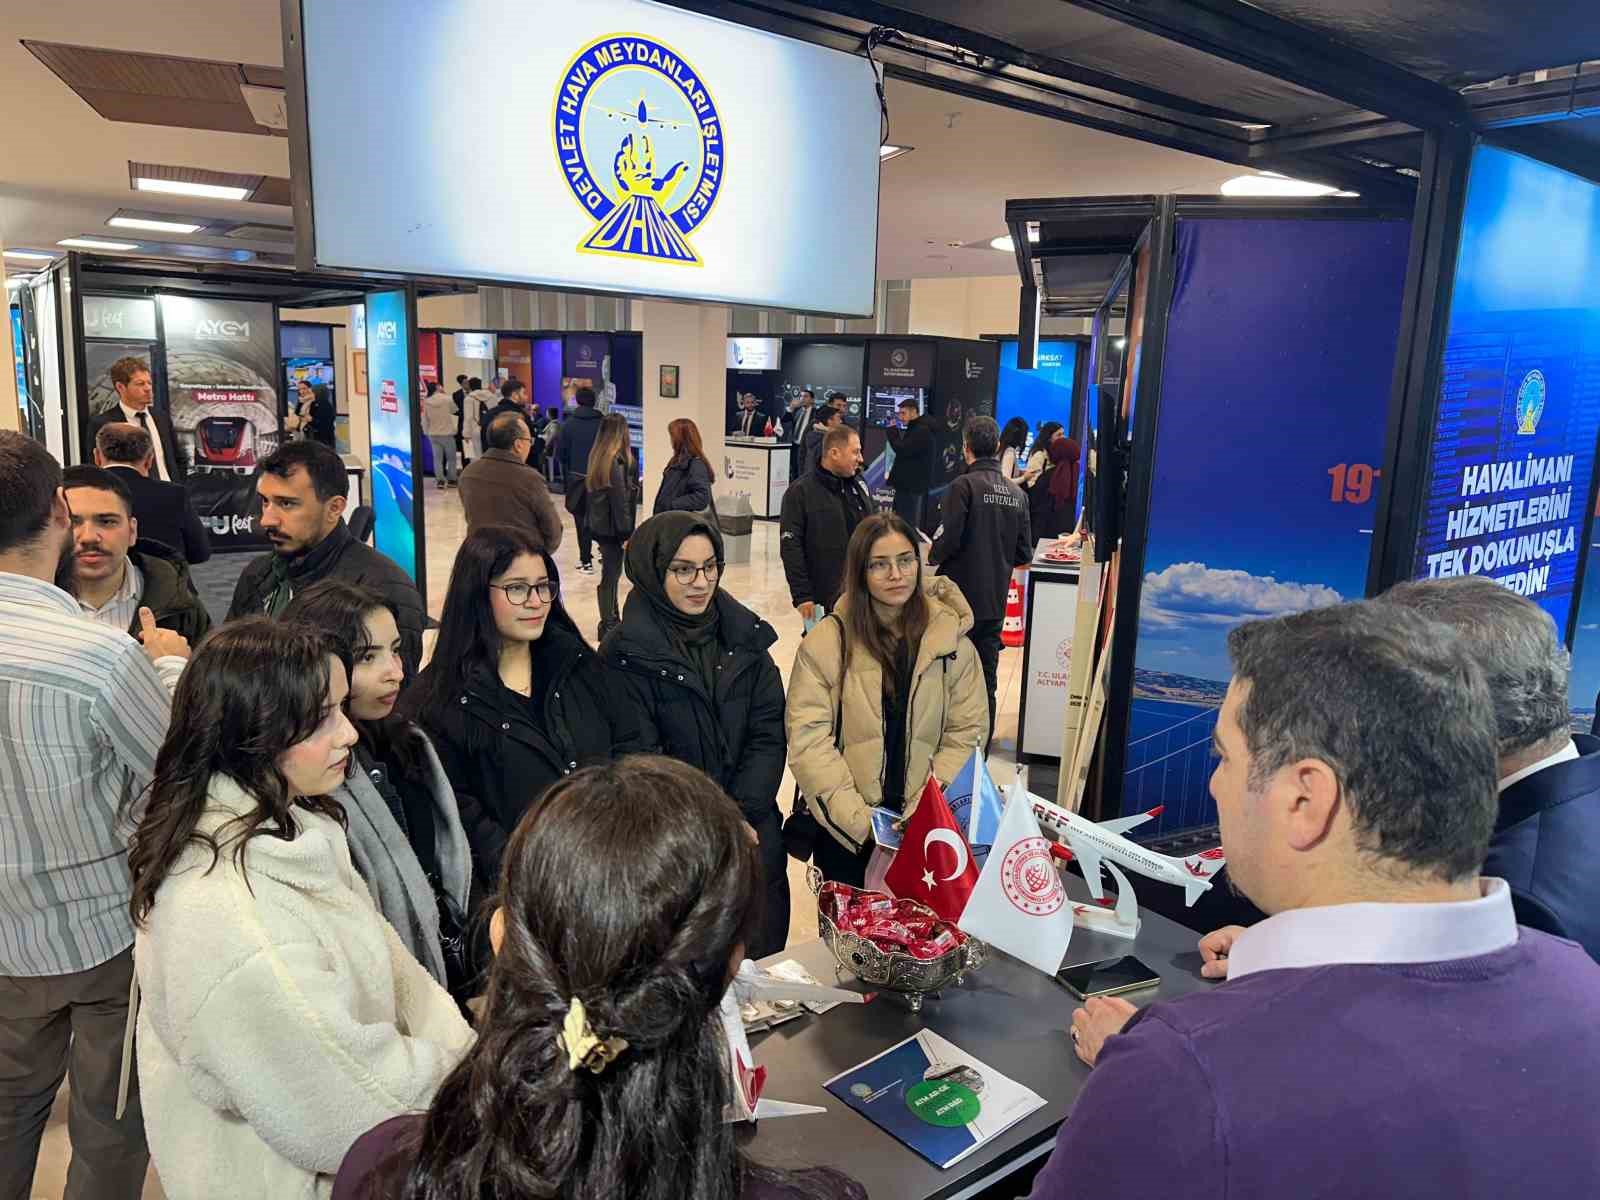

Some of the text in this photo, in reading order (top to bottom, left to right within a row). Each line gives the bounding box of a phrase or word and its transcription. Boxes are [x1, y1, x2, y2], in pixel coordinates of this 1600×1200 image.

[561, 59, 598, 115] HAVA
[594, 42, 710, 114] MEYDANLARI
[560, 124, 601, 211] DEVLET
[197, 391, 227, 402] Metro
[1328, 463, 1381, 504] 19
[1462, 453, 1574, 496] HAVALİMANI
[231, 513, 255, 535] fest
[1446, 486, 1572, 541] HİZMETLERİNİ
[1427, 527, 1575, 579] TEK DOKUNUŞLA
